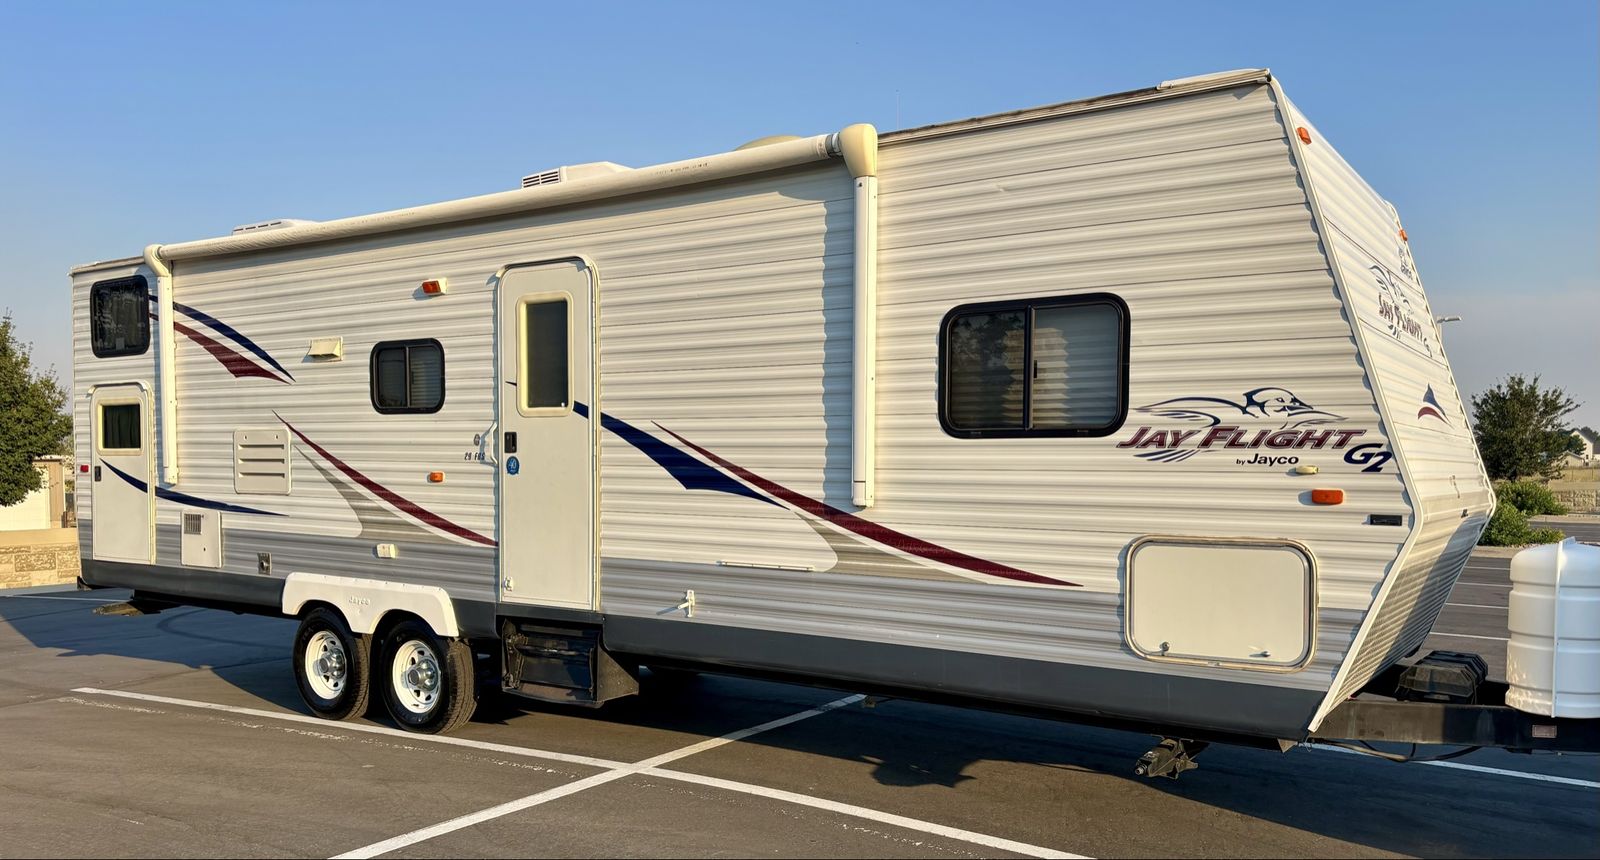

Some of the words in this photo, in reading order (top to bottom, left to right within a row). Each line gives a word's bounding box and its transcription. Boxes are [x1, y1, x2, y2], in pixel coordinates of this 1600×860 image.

[1116, 427, 1202, 449] JAY
[1199, 426, 1368, 449] FLIGHT
[1236, 458, 1247, 466] by
[1247, 453, 1300, 466] Jayco
[1343, 443, 1393, 473] G2
